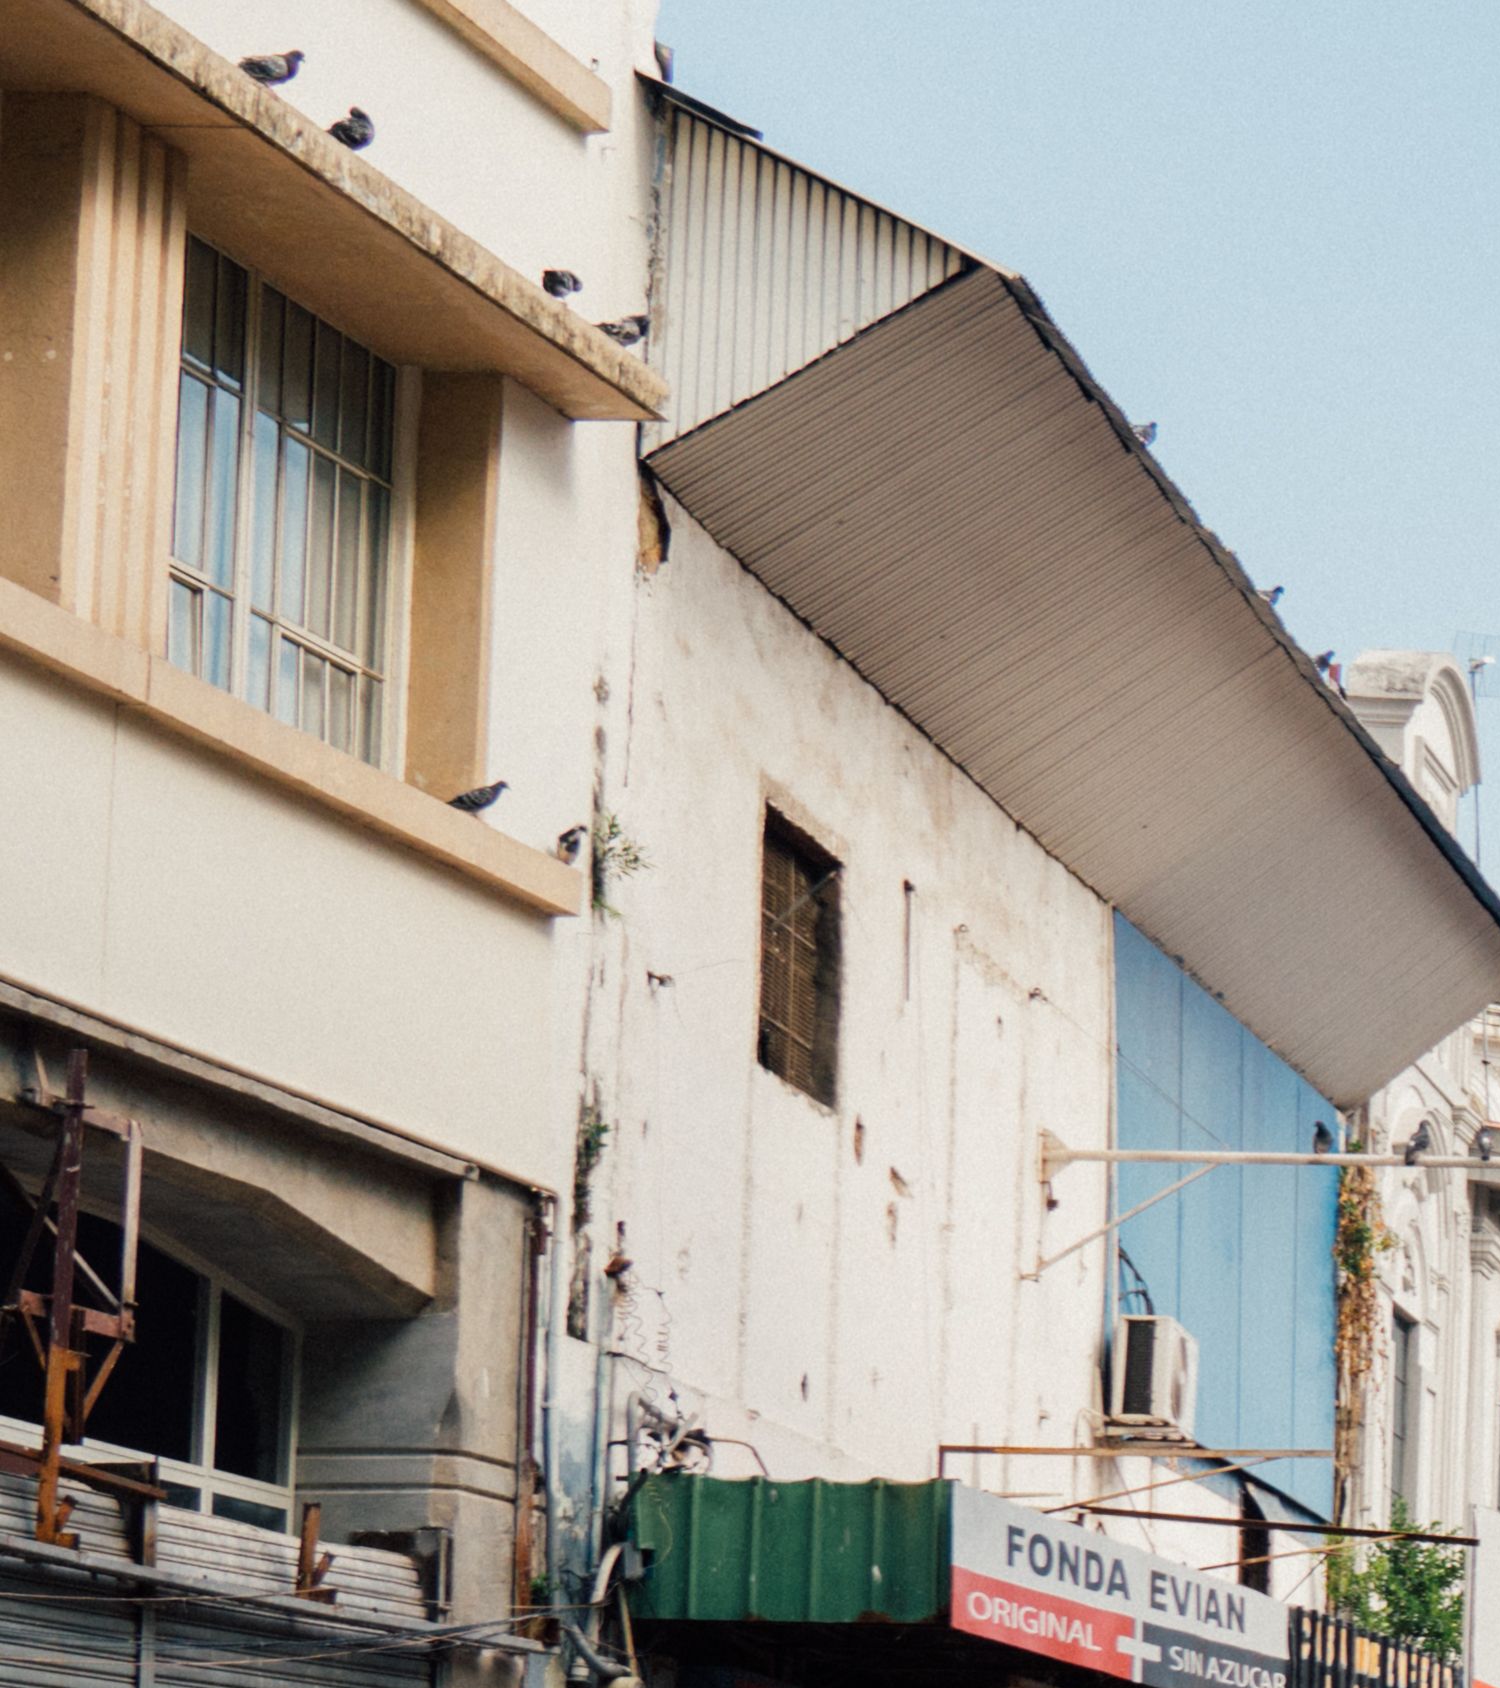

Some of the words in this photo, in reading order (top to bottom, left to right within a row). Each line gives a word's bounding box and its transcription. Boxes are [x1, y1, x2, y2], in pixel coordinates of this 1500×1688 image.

[1006, 1524, 1131, 1600] FONDA
[1149, 1568, 1246, 1634] EVIAN
[966, 1590, 1102, 1652] ORIGINAL
[1168, 1645, 1204, 1677] SIN
